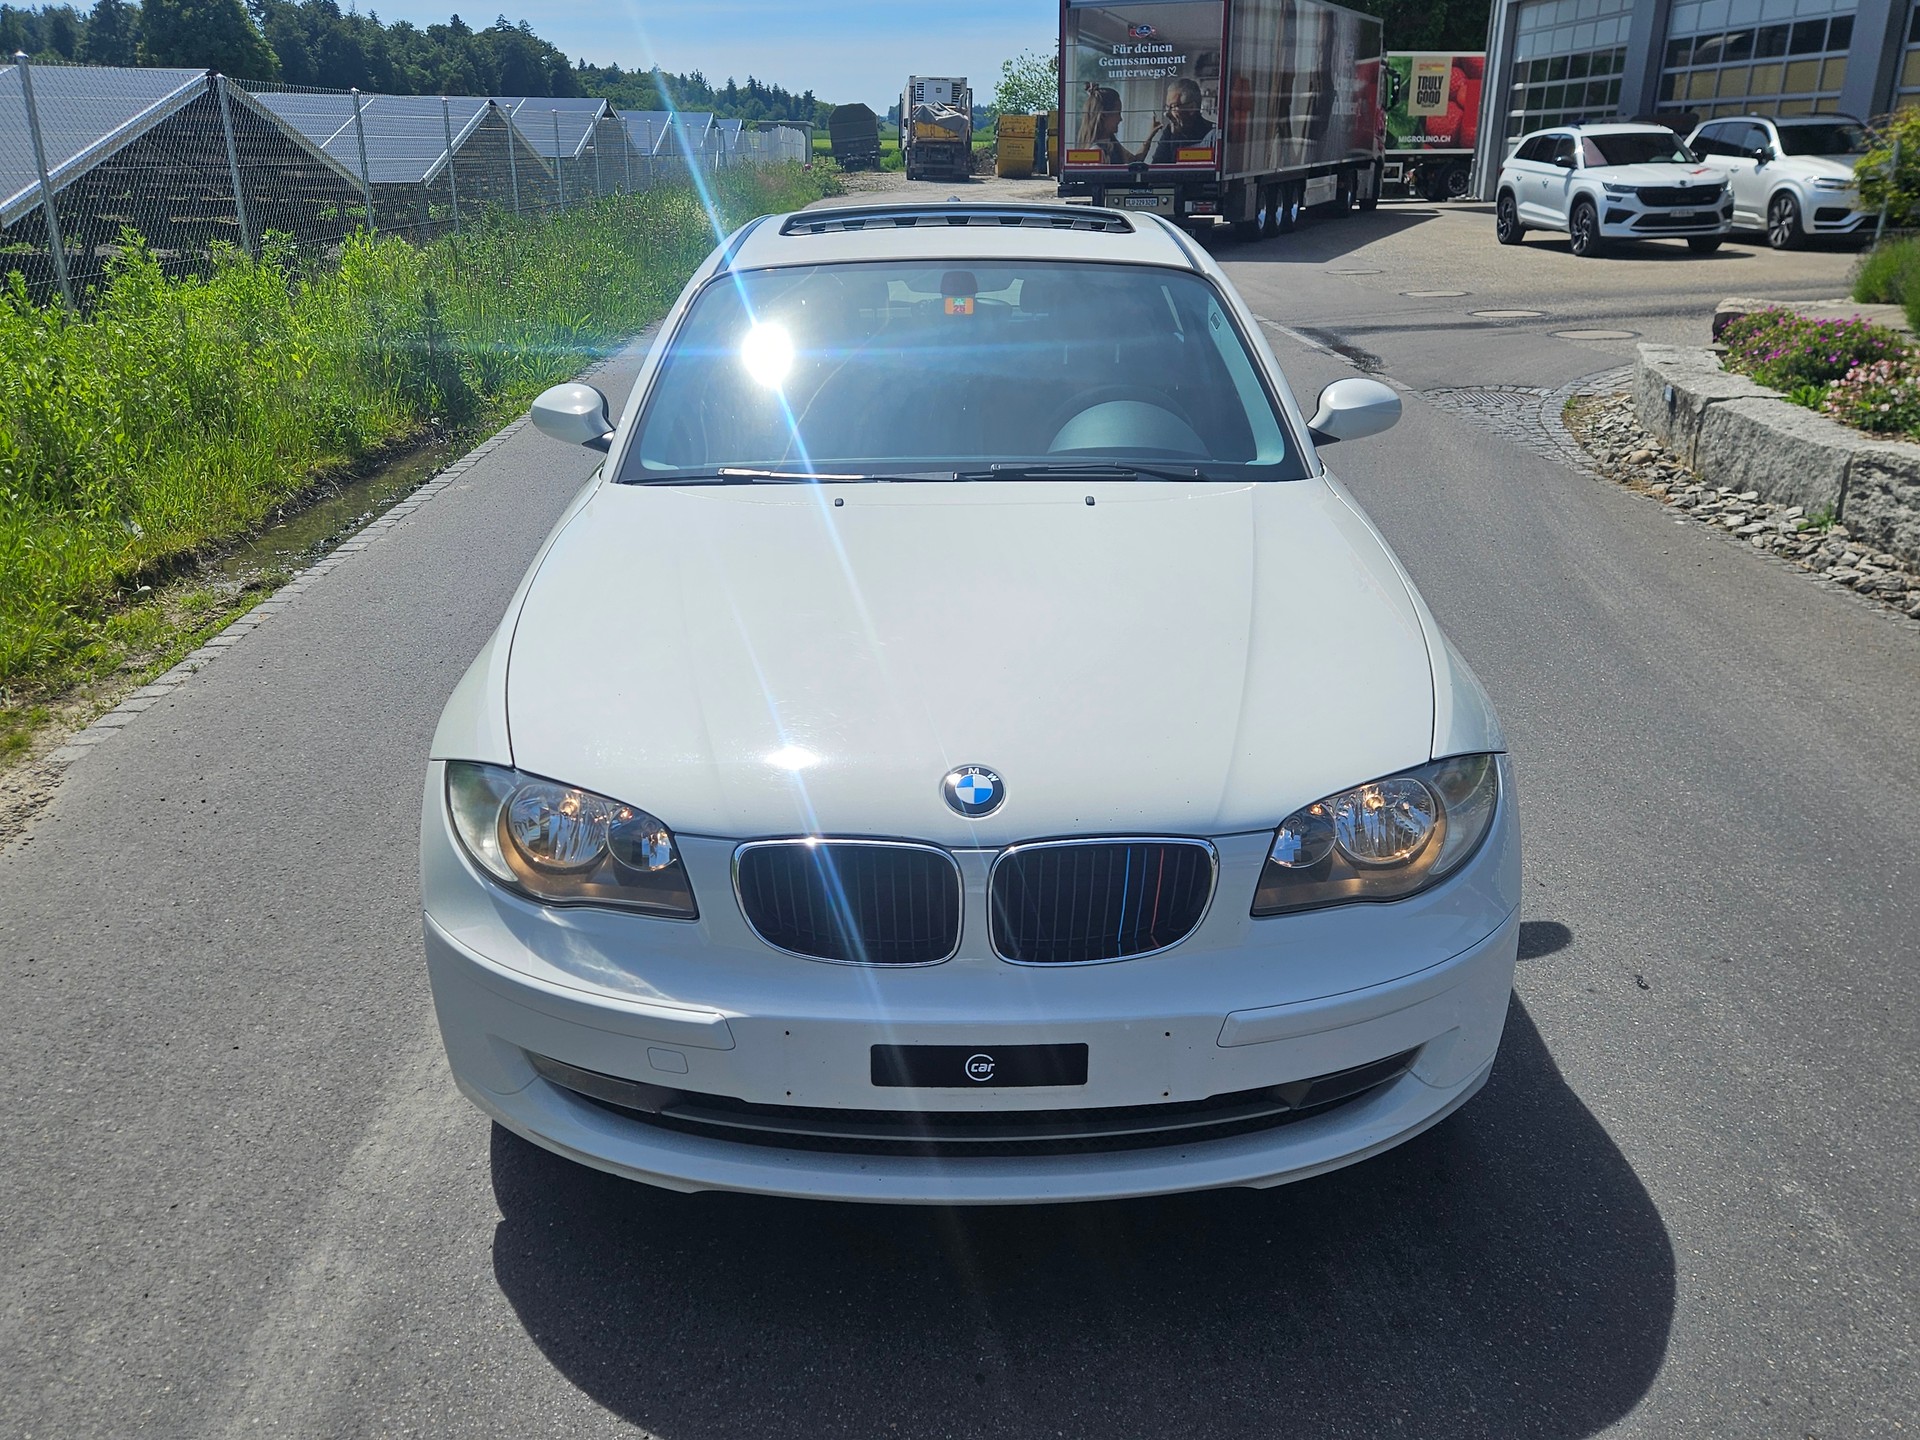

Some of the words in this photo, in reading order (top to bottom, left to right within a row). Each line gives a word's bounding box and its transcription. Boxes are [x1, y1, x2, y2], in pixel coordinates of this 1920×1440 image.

[1112, 43, 1132, 54] Für
[1134, 42, 1173, 54] deinen
[1098, 55, 1186, 67] Genussmoment
[1108, 67, 1166, 79] unterwegs
[1418, 75, 1443, 90] TRULY
[1416, 90, 1441, 104] GOOD
[1398, 135, 1452, 143] MIGROLINO.CH
[946, 767, 1000, 784] MW
[970, 1062, 995, 1073] car
